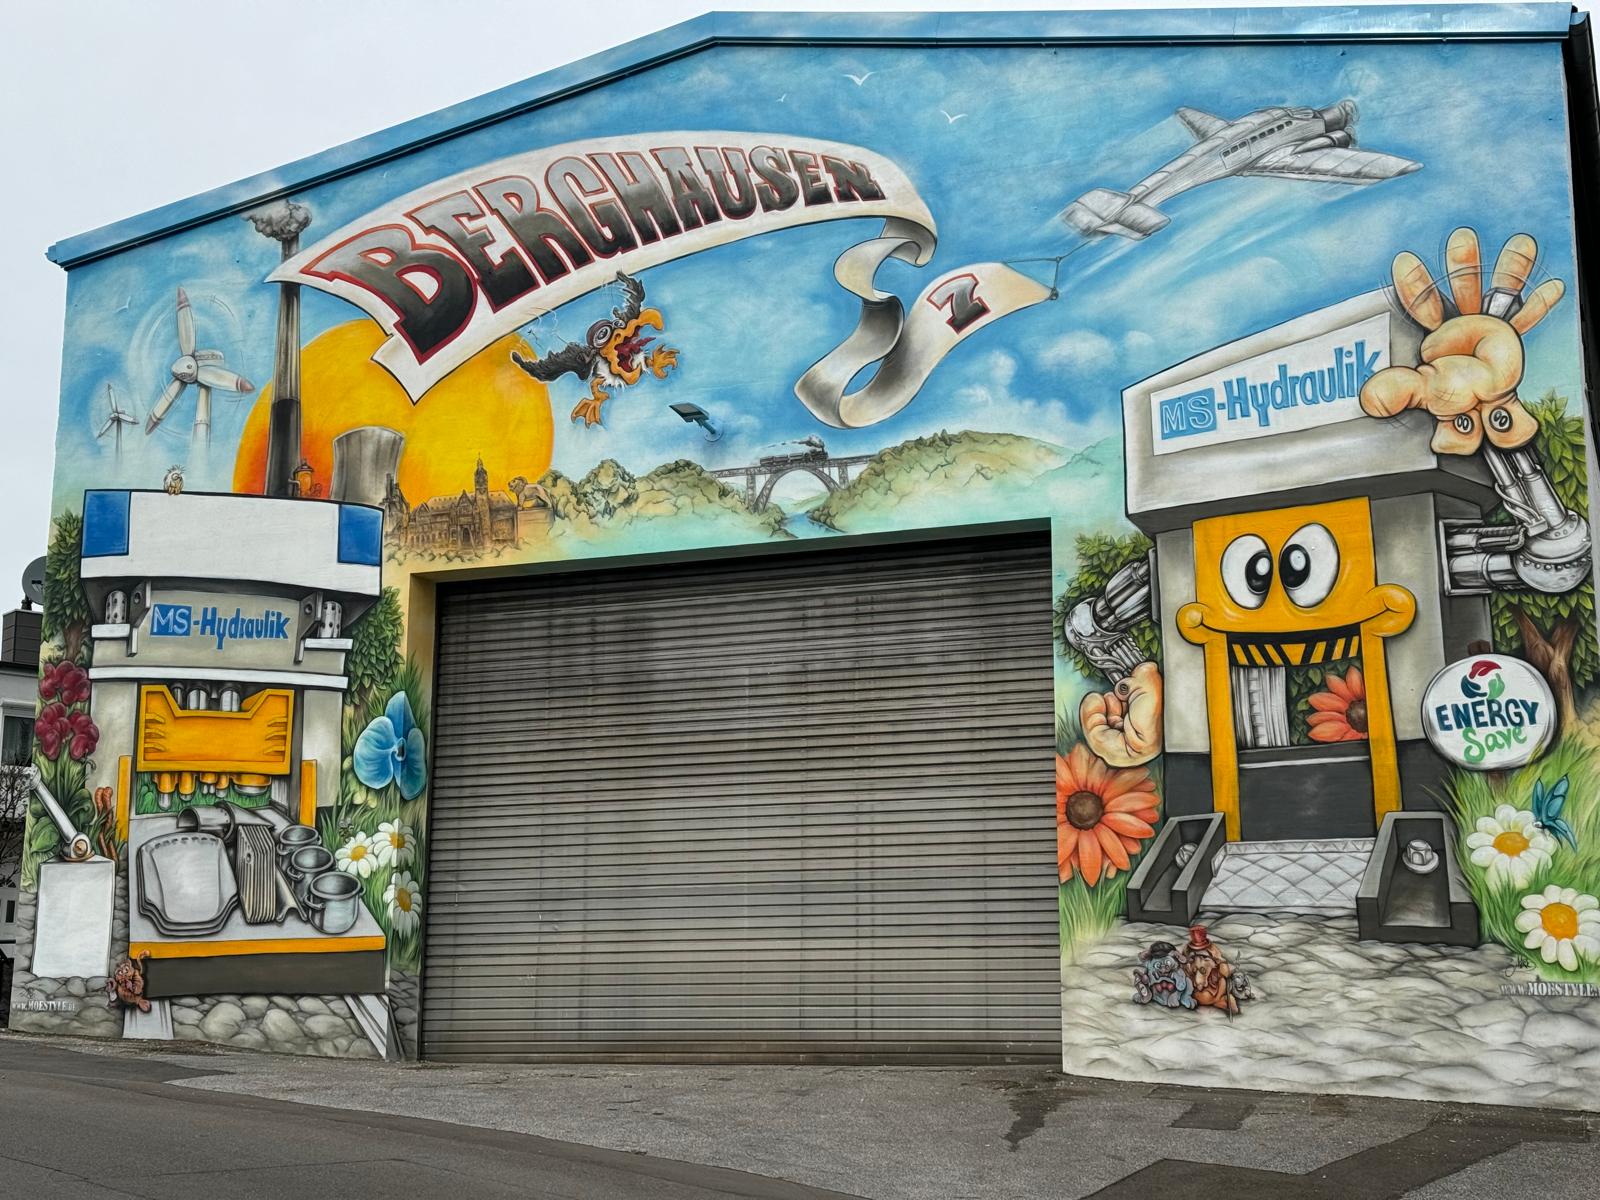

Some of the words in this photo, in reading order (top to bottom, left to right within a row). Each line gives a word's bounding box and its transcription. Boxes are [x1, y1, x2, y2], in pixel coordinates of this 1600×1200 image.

[299, 145, 886, 364] BERGHAUSEN
[1159, 339, 1383, 440] MS-Hydraulik
[150, 603, 291, 650] MS-Hydraulik
[1435, 698, 1539, 731] ENERGY
[1462, 726, 1528, 764] Save
